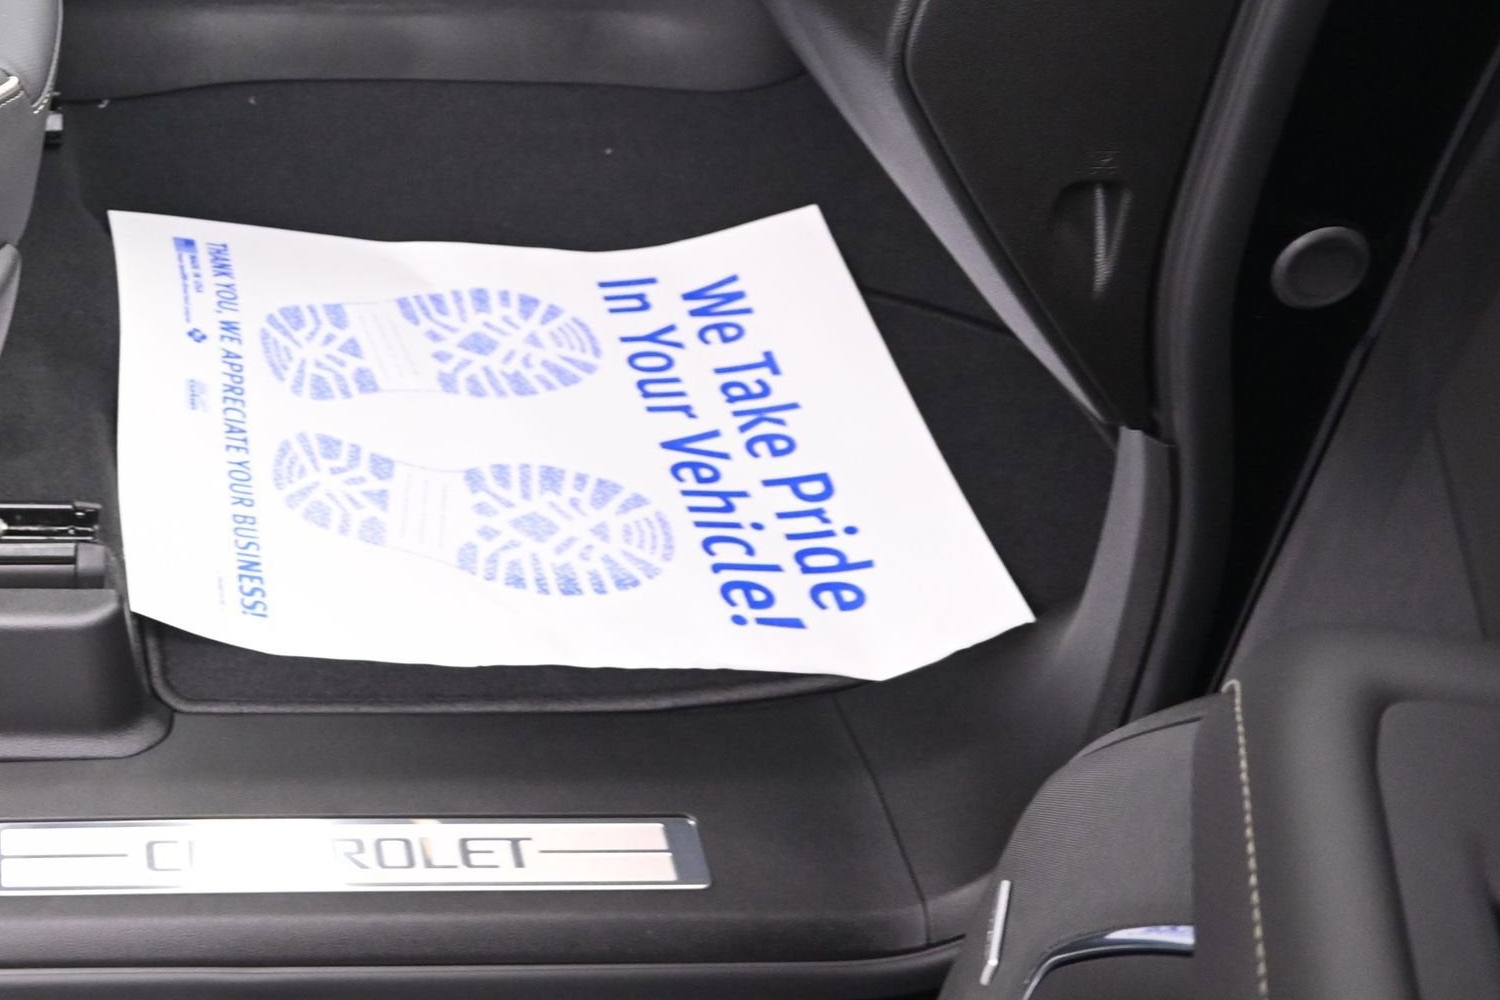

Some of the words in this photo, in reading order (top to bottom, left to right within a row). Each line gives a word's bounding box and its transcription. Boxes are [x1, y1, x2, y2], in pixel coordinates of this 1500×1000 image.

[205, 241, 237, 280] THANK
[596, 276, 660, 315] In
[214, 282, 240, 314] YOU,
[218, 319, 243, 346] WE
[681, 273, 755, 346] We
[220, 346, 250, 455] APPRECIATE
[618, 323, 698, 420] Your
[712, 350, 802, 459] Take
[227, 460, 255, 508] YOUR
[659, 428, 808, 630] Vehicle!
[760, 471, 877, 613] Pride
[232, 513, 269, 619] BUSINESS!
[146, 837, 533, 872] CROLET
